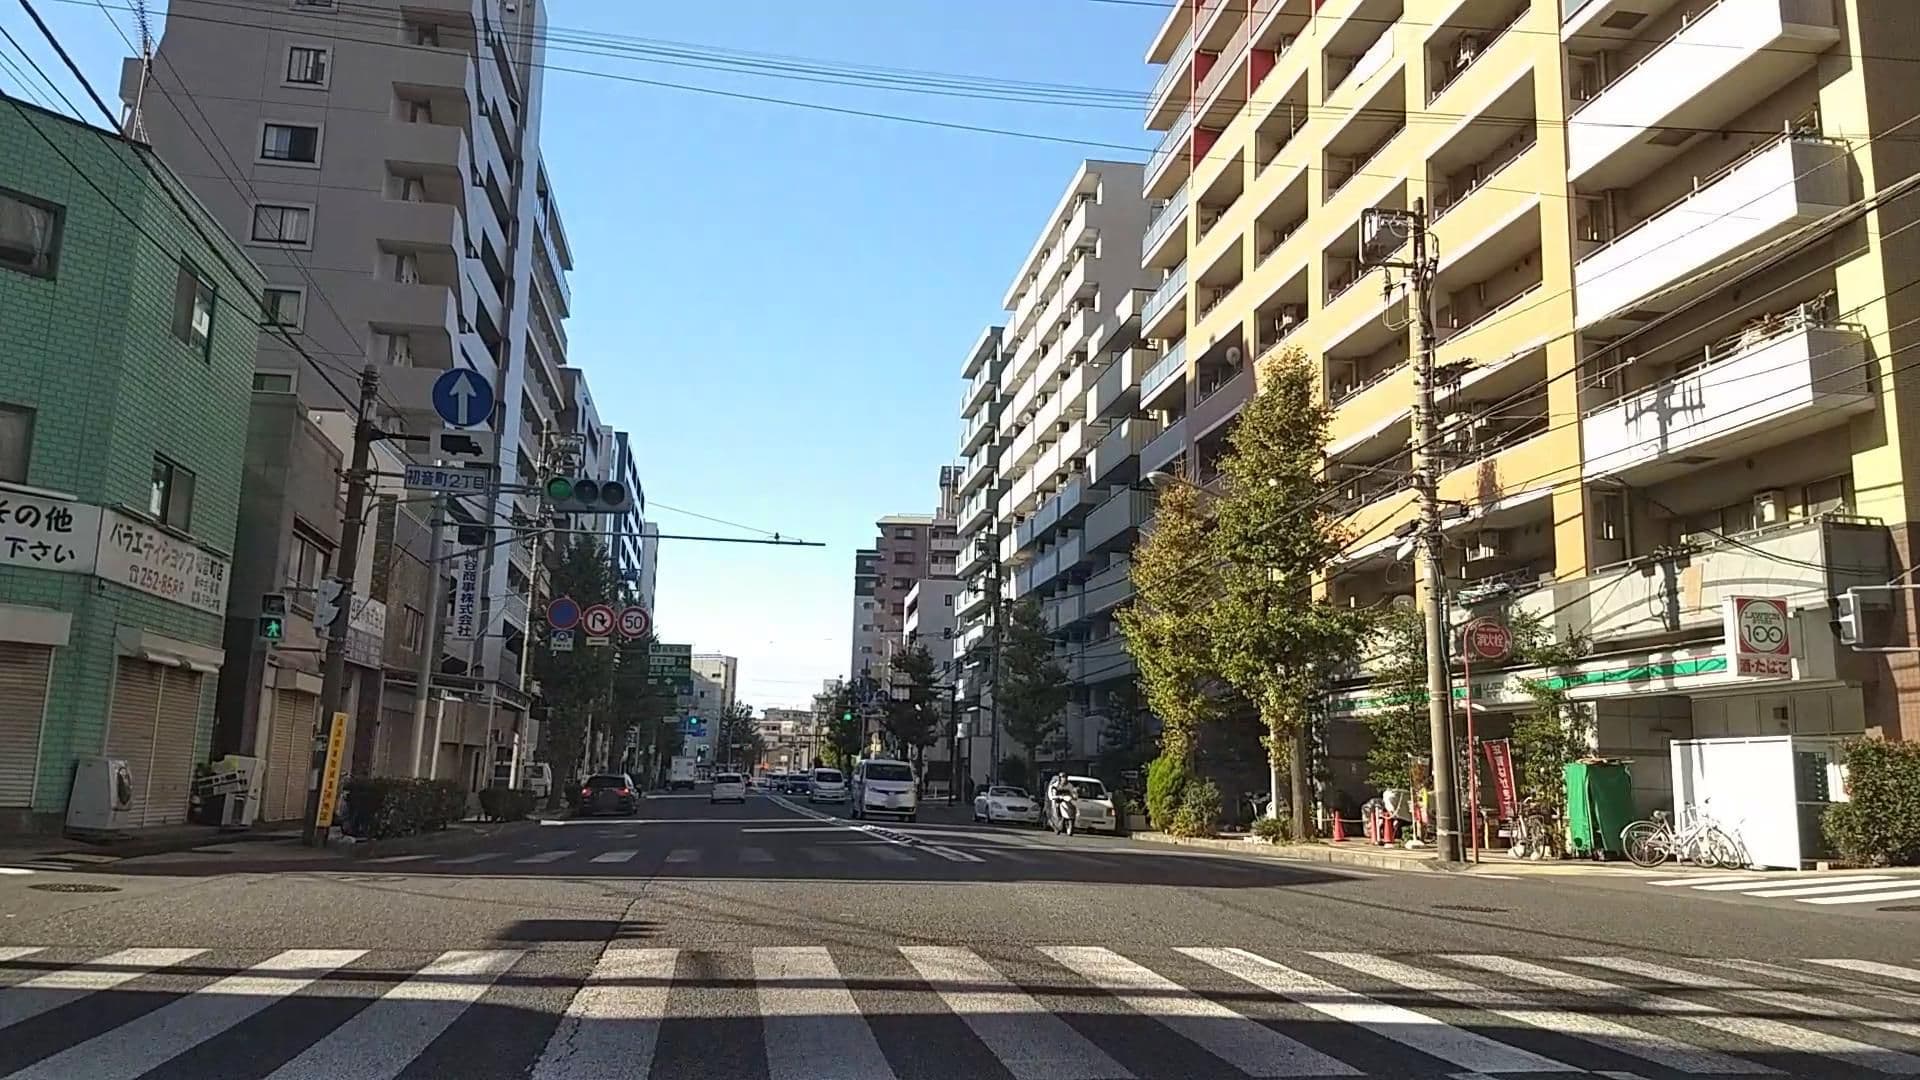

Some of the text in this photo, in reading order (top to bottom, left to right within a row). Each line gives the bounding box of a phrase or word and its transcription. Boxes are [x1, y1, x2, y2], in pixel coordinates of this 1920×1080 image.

[407, 469, 485, 490] 初音町2丁目
[4, 536, 75, 563] 下さい
[624, 615, 643, 629] 50
[1476, 632, 1504, 648] 消火栓
[1743, 624, 1783, 643] 100
